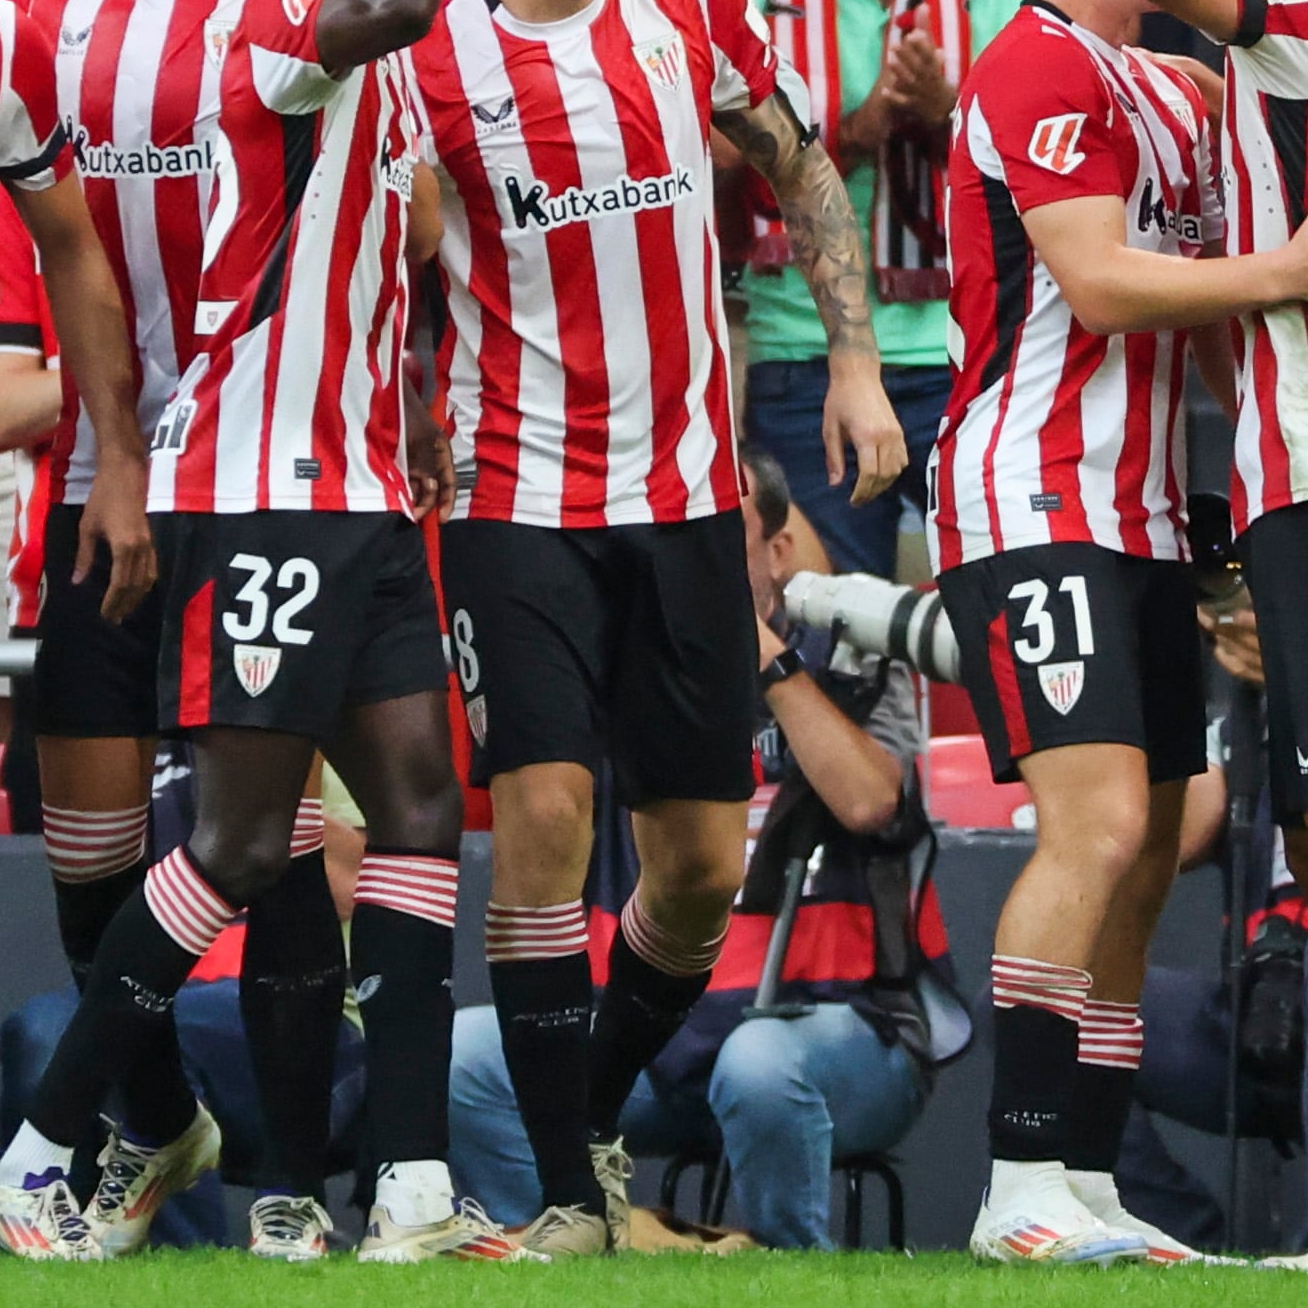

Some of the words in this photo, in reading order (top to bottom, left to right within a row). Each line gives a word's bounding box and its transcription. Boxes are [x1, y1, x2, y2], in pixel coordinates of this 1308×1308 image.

[222, 553, 321, 645] 32
[1007, 575, 1095, 664] 31
[453, 608, 480, 693] 8
